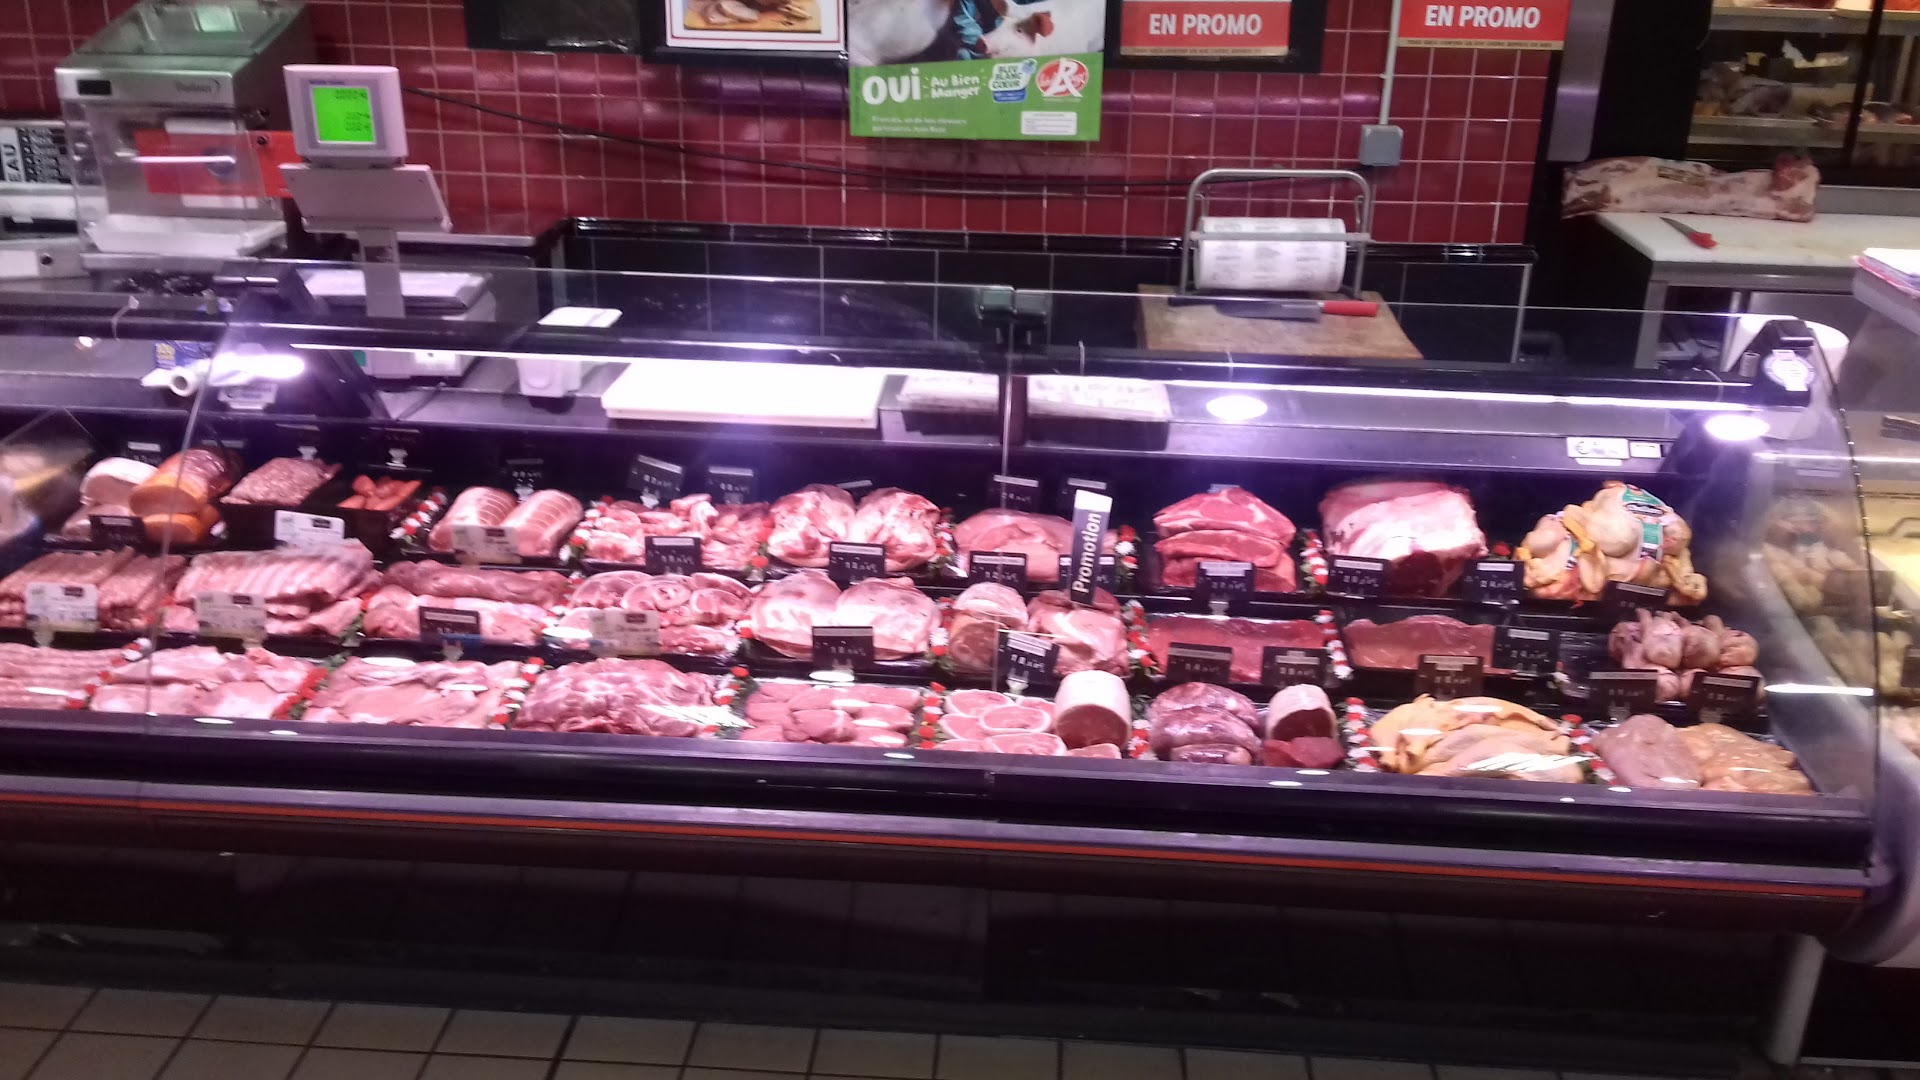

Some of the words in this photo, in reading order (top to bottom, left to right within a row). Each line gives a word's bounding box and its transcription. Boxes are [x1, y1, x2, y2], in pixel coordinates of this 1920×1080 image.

[1149, 13, 1177, 35] EN
[1182, 14, 1263, 35] PROMO
[1425, 5, 1455, 27] EN
[1458, 5, 1541, 29] PROMO
[930, 76, 949, 87] Au
[951, 74, 980, 86] Bien
[930, 87, 980, 99] Manger
[1072, 512, 1102, 594] Promotion
